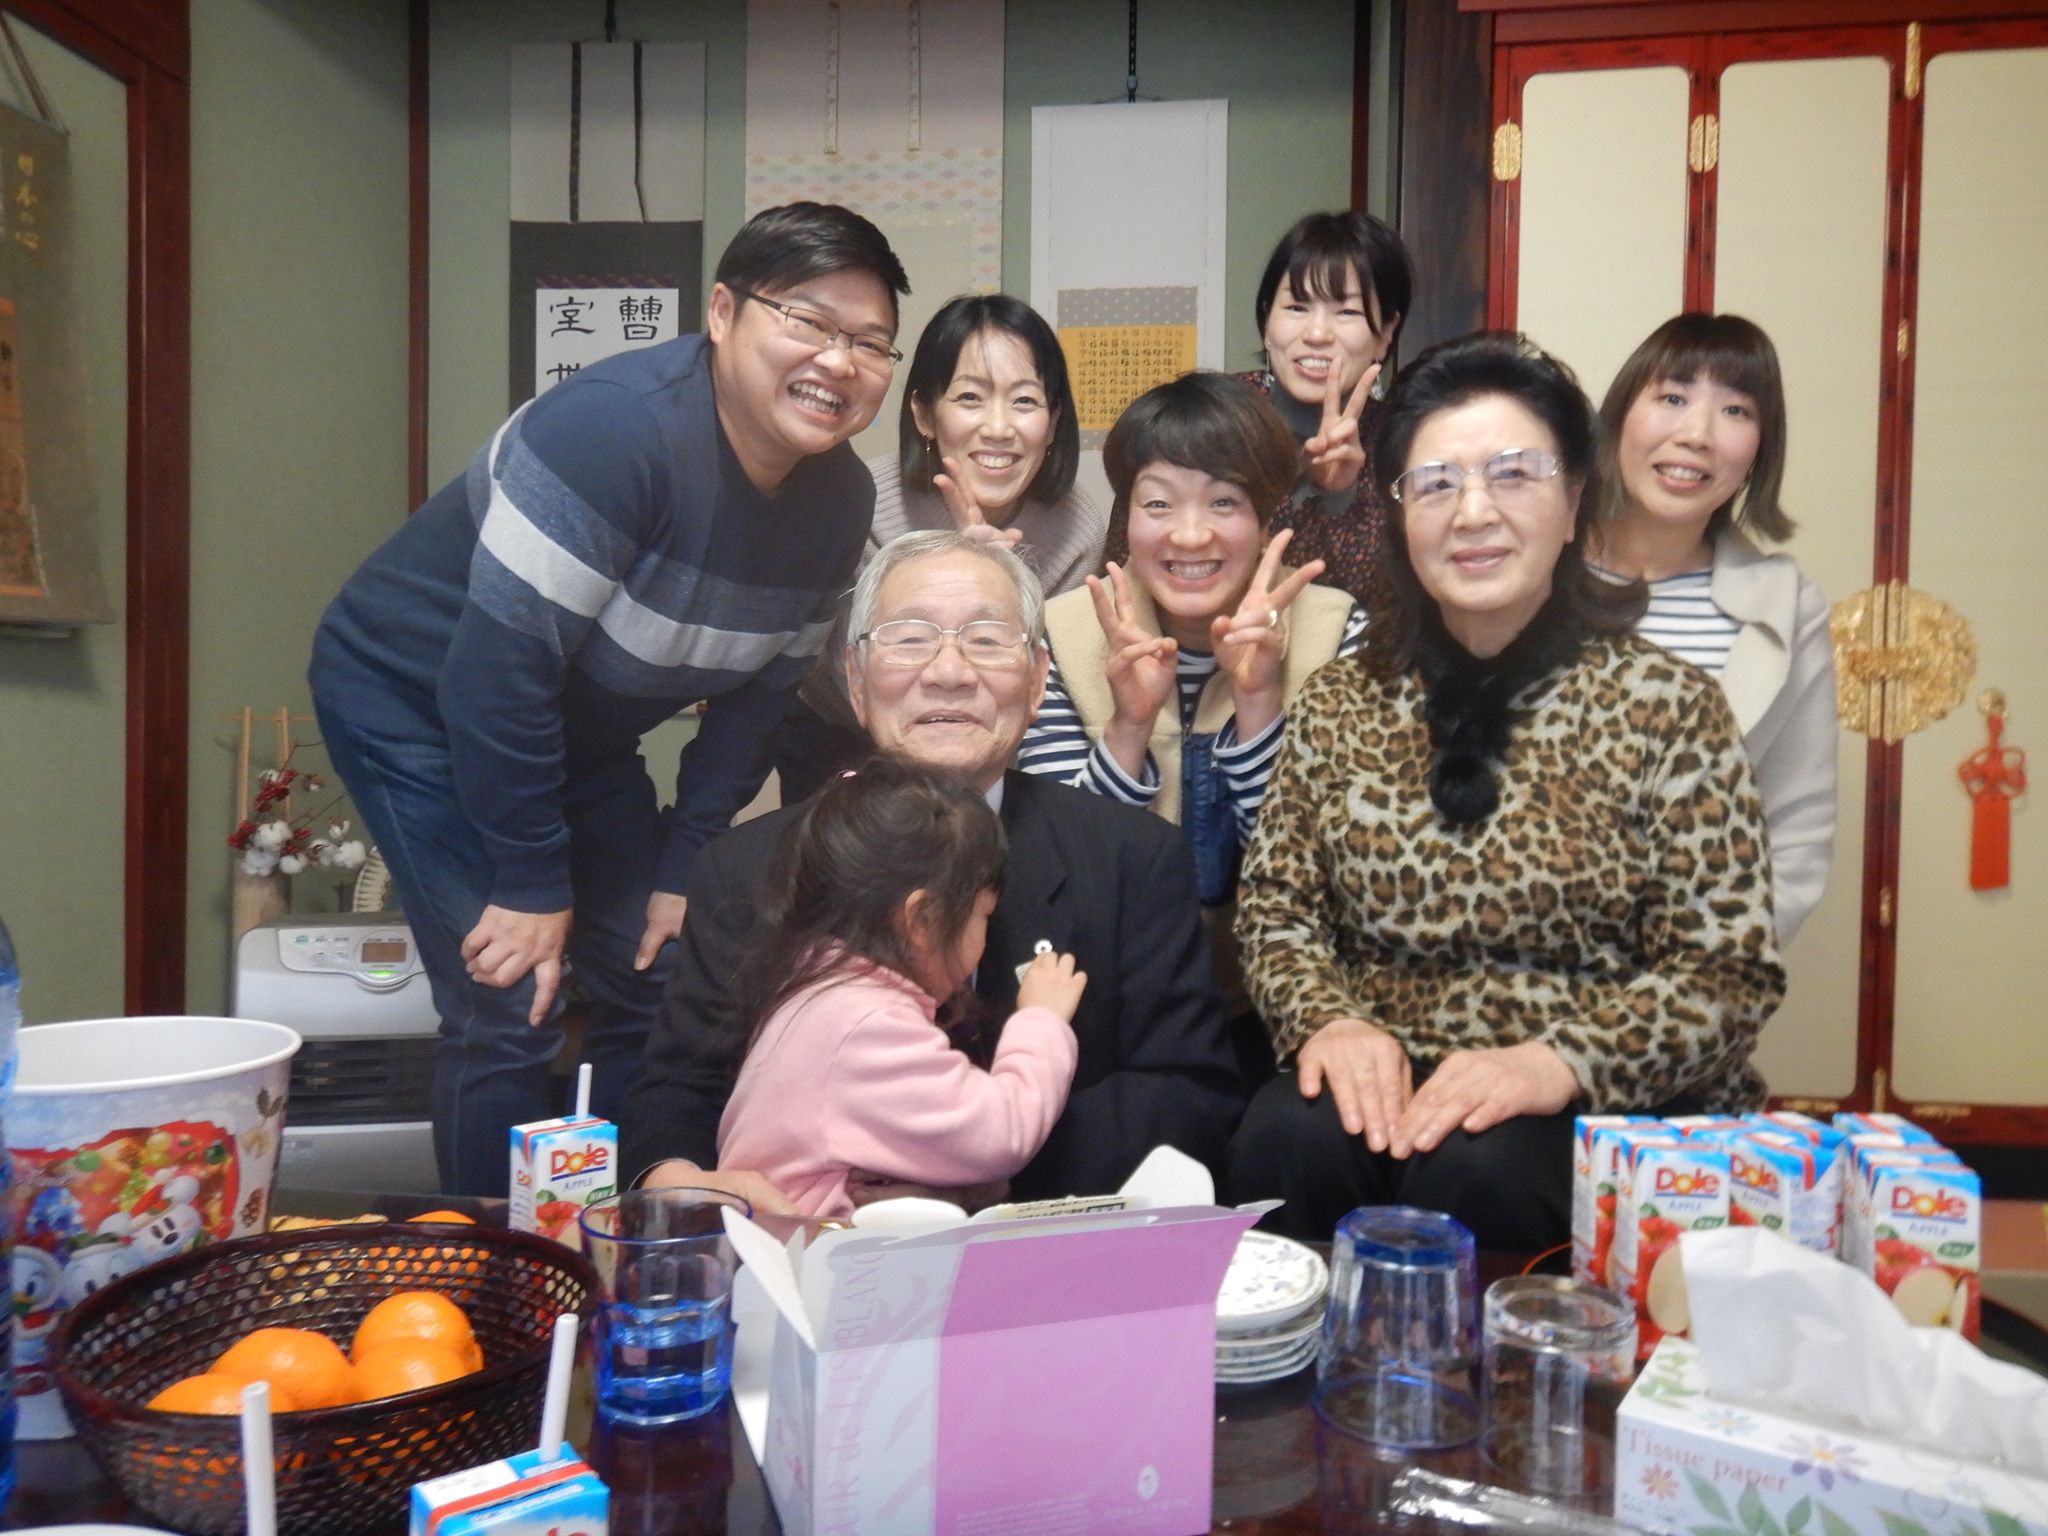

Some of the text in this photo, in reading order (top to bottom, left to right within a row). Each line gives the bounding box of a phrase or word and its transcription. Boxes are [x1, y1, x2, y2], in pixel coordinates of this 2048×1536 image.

[551, 1143, 609, 1176] Dole
[1730, 1153, 1779, 1193] Dole
[1655, 1167, 1720, 1195] Dole
[1891, 1185, 1968, 1218] Dole
[1713, 1459, 1790, 1493] paper
